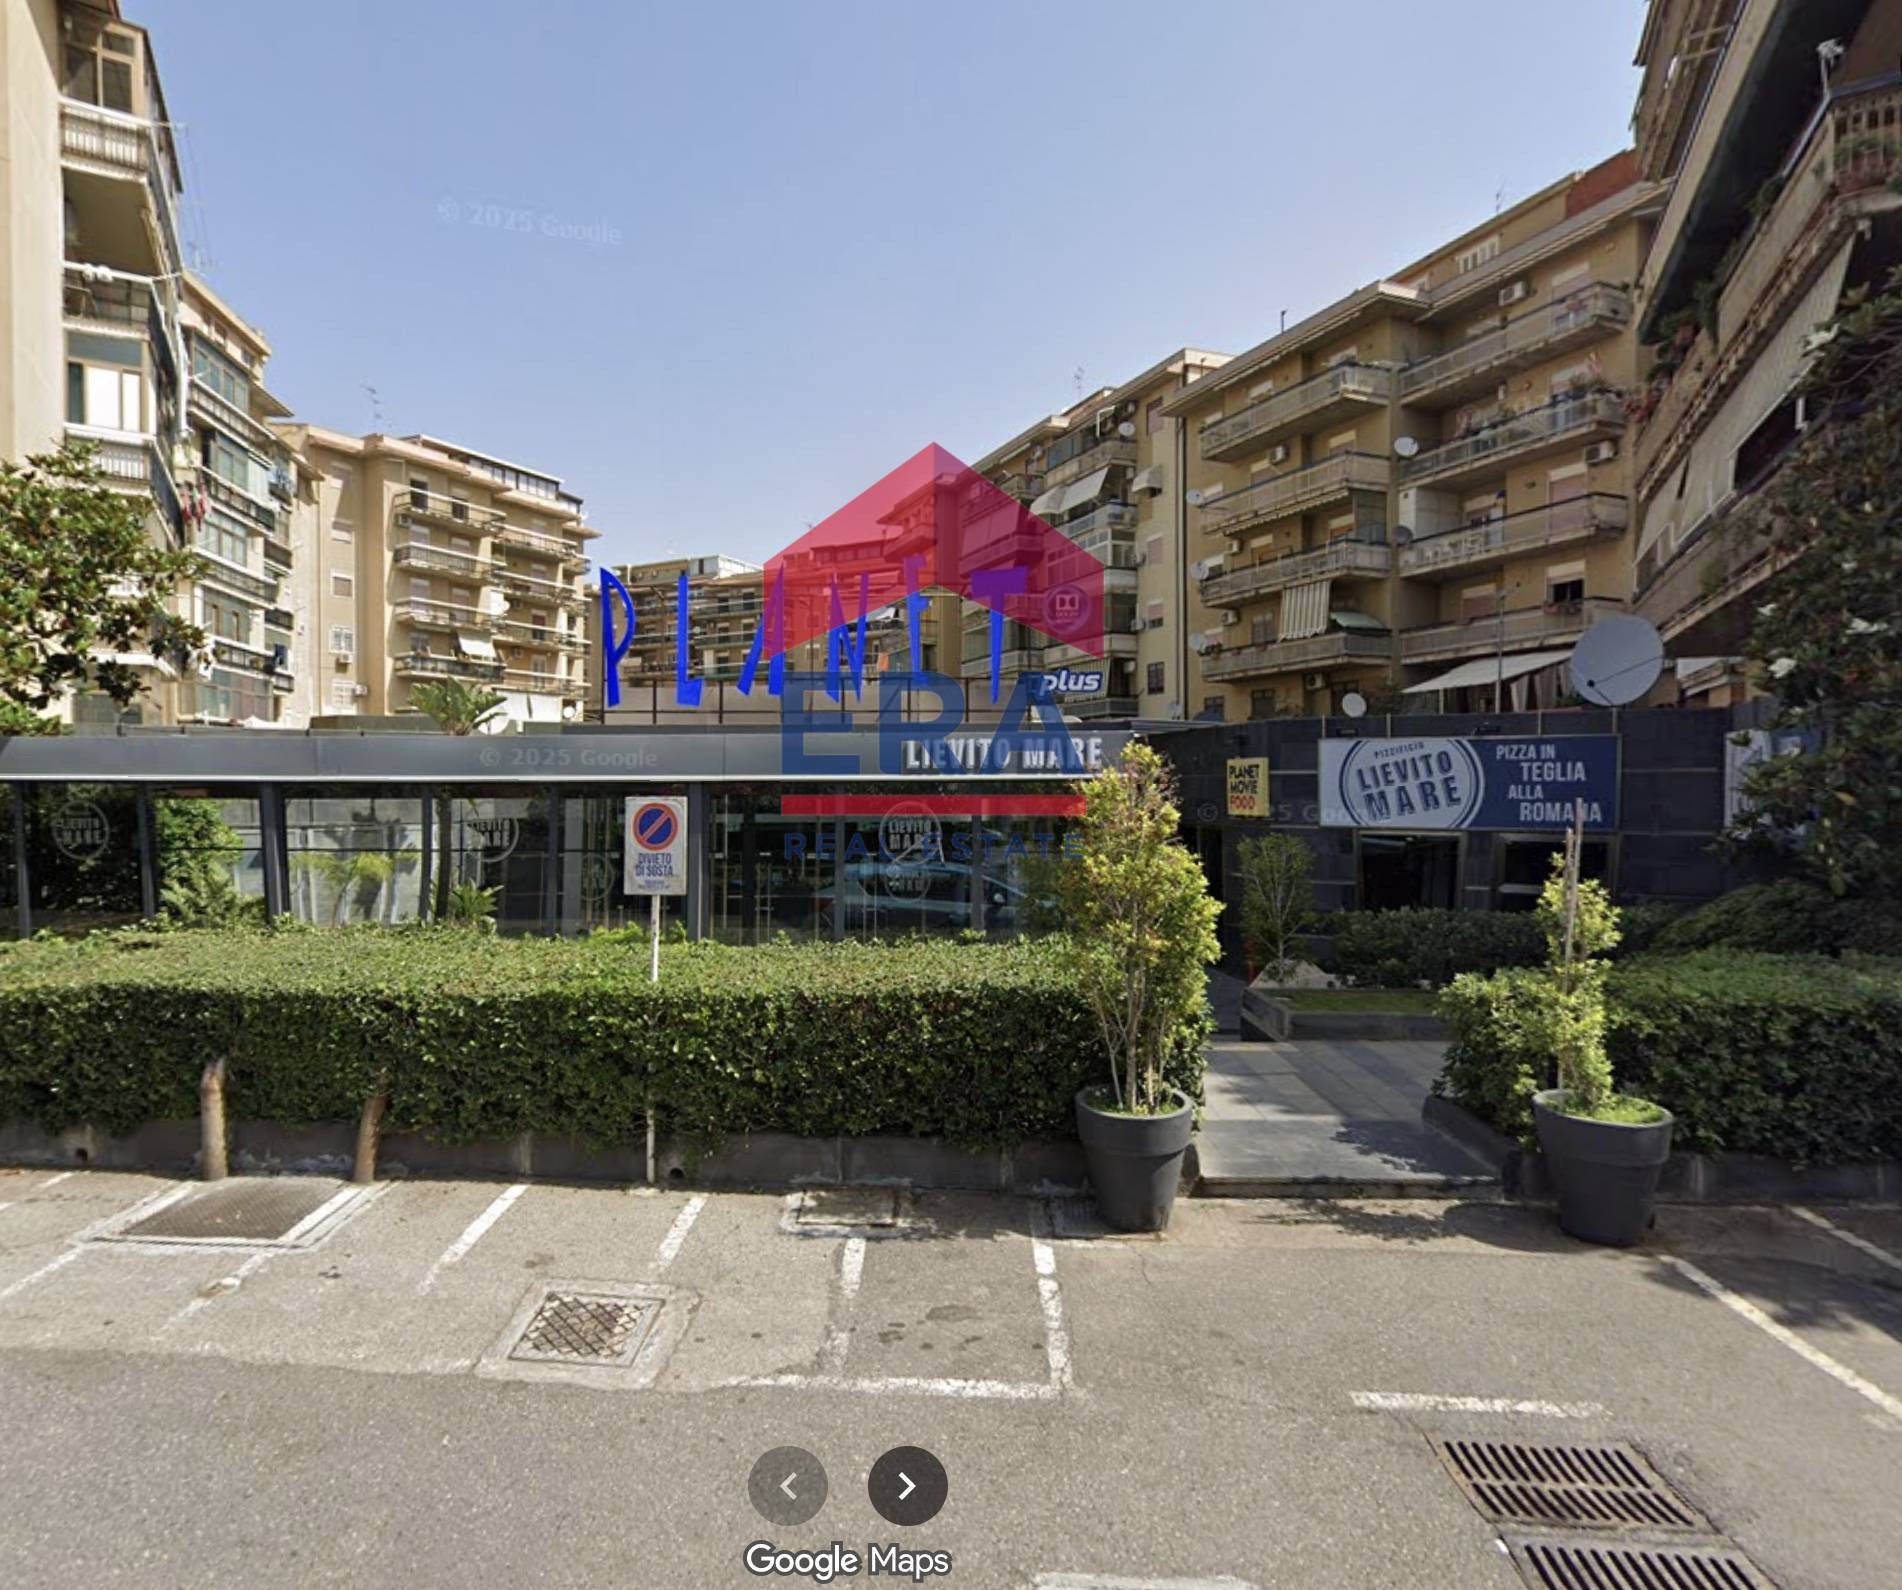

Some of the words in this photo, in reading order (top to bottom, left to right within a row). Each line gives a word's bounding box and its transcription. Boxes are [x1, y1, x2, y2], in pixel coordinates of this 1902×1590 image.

[1039, 669, 1101, 697] plus
[906, 738, 1011, 769] LIEVITO
[1022, 737, 1103, 769] MARE
[1496, 744, 1537, 760] PIZZA
[1540, 744, 1555, 759] IN
[1229, 765, 1260, 779] PLANET
[1356, 750, 1452, 791] LIEVITO
[1520, 761, 1587, 782] TEGLIA
[1230, 780, 1257, 795] MOVIE
[1508, 784, 1544, 799] ALLA
[1230, 796, 1256, 810] FOOD
[1363, 774, 1462, 821] MARE
